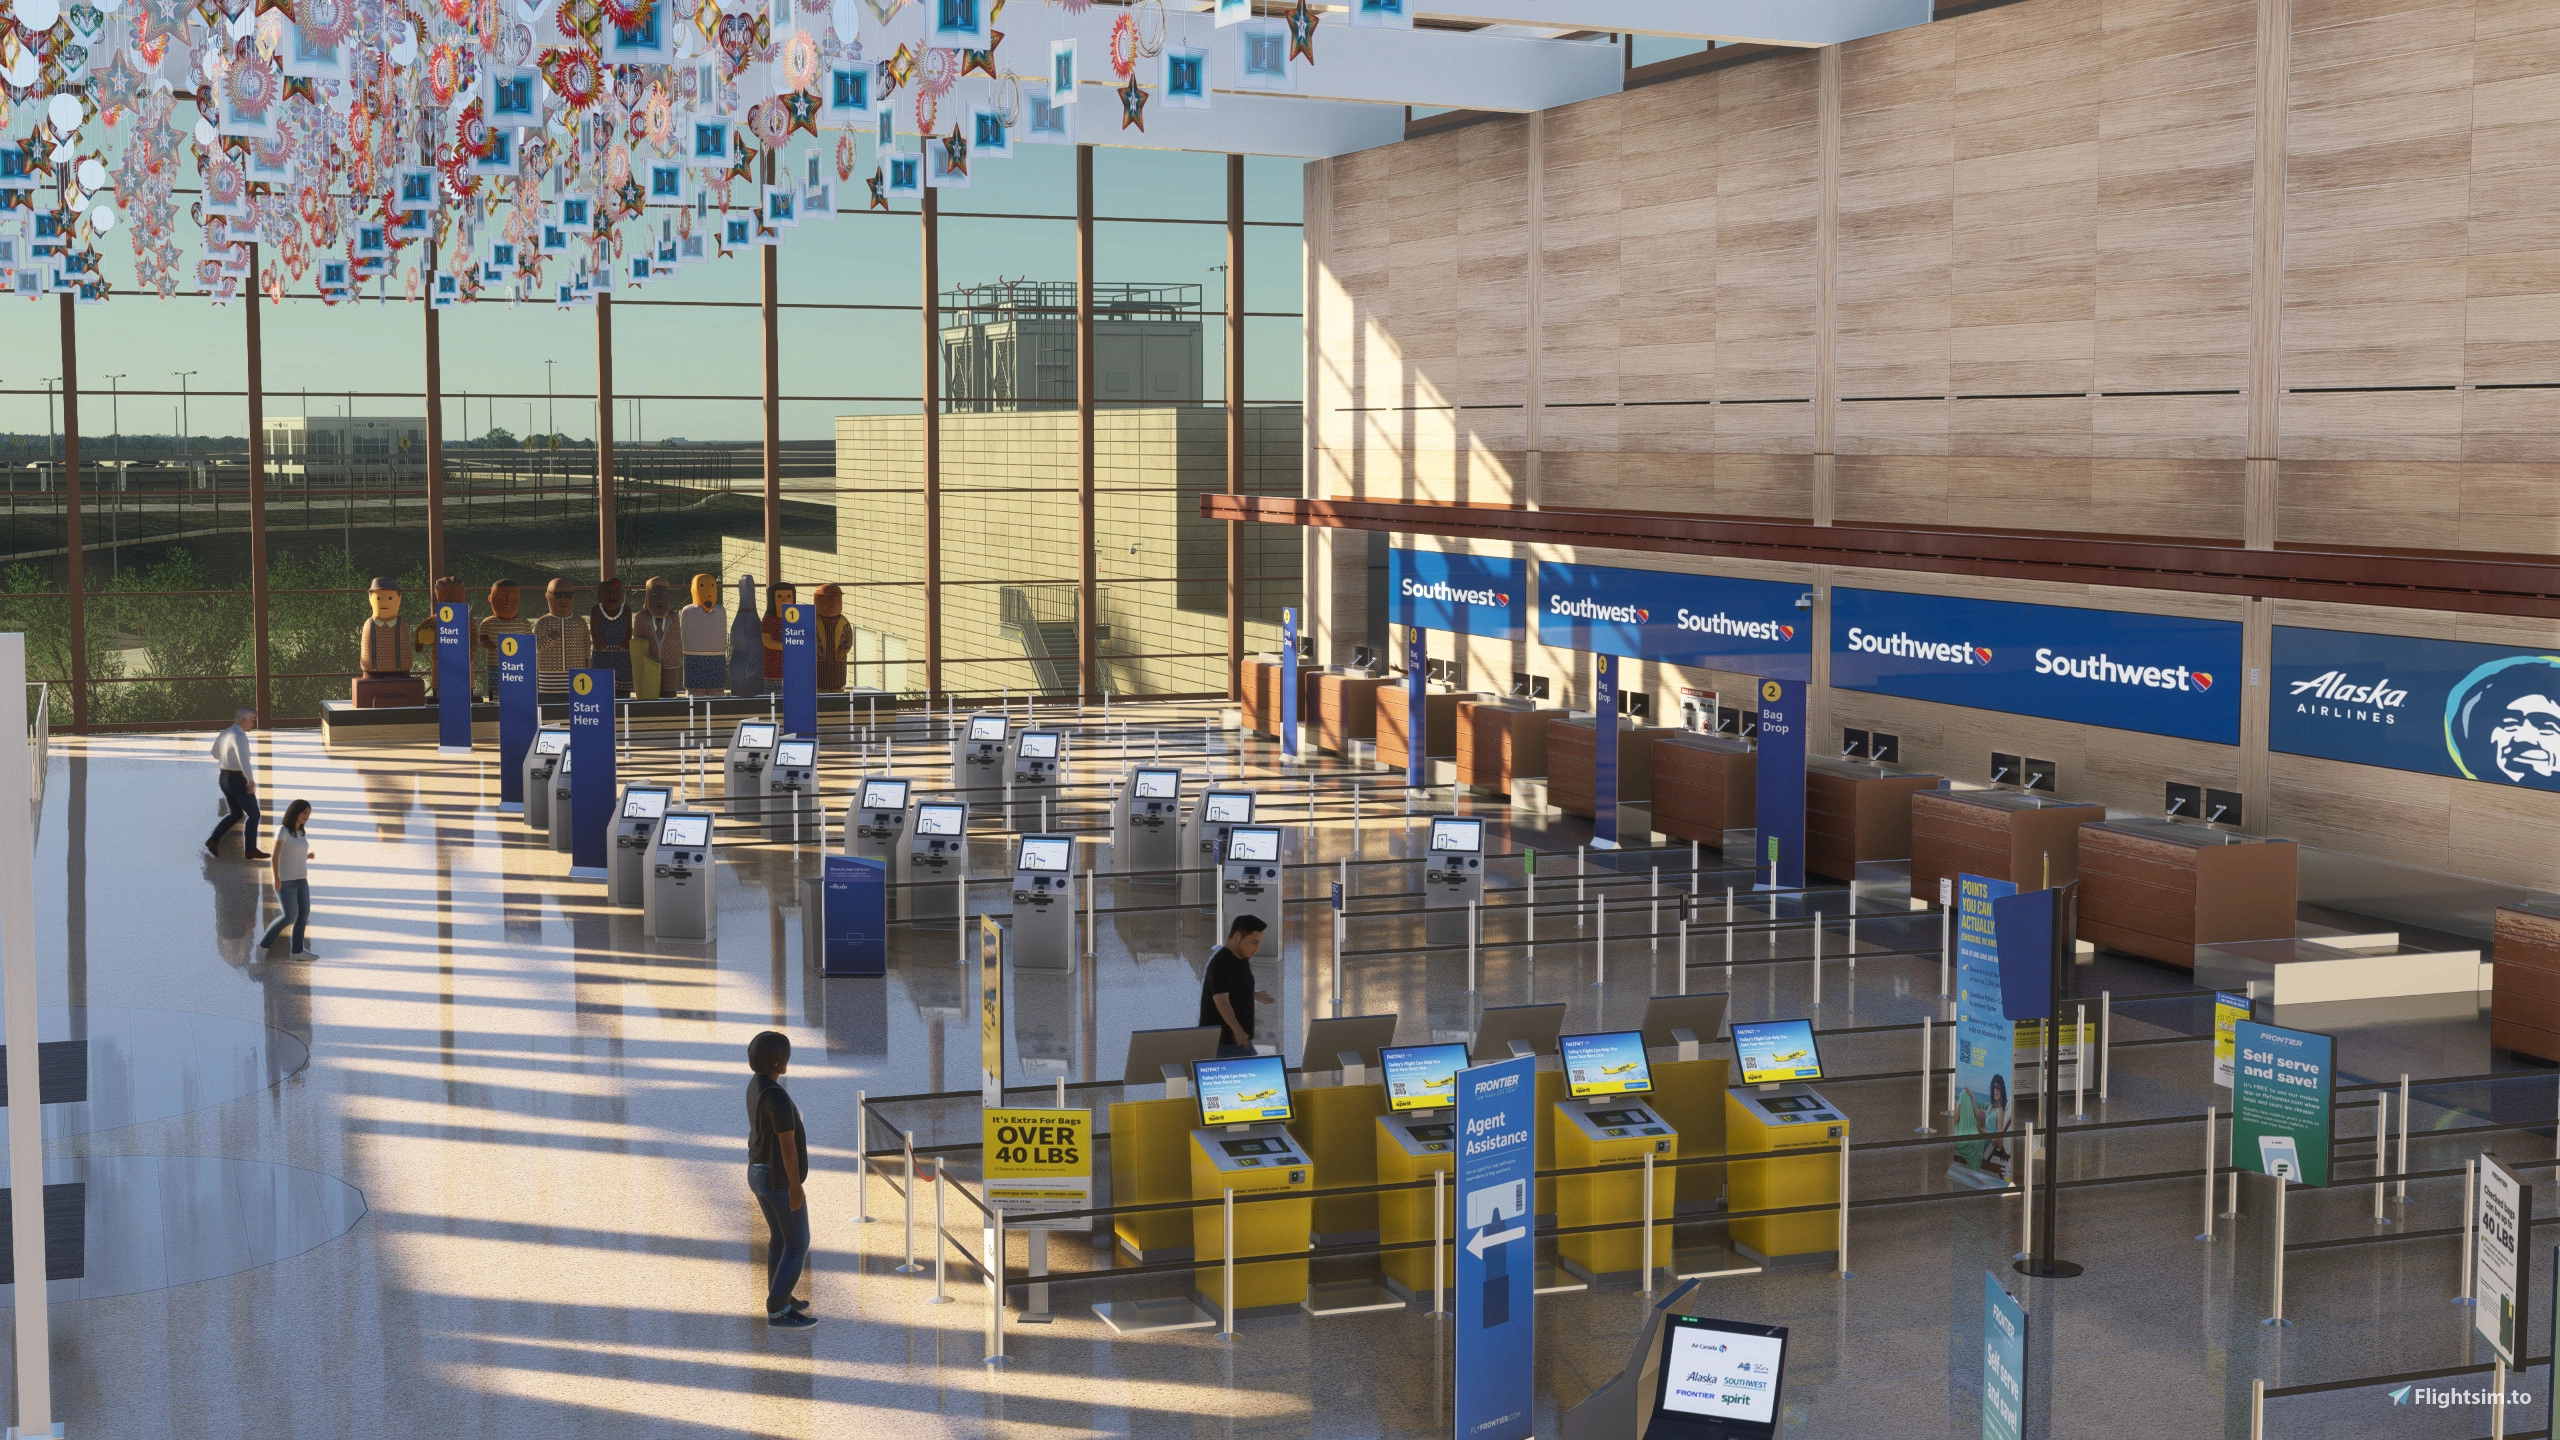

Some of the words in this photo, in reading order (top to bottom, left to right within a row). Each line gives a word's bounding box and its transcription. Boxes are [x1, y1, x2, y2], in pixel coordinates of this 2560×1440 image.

[1402, 578, 1495, 606] Southwest
[444, 609, 449, 619] 1
[789, 610, 795, 620] 1
[1550, 595, 1637, 624] Southwest
[439, 626, 459, 636] Start
[785, 627, 805, 636] Start
[1677, 608, 1779, 641] Southwest
[439, 636, 459, 645] Here
[506, 641, 512, 652] 1
[785, 637, 805, 645] Here
[1848, 627, 1973, 665] Southwest
[501, 661, 525, 672] Start
[2035, 647, 2190, 691] Southwest
[501, 672, 524, 682] Here
[579, 678, 586, 691] 1
[1598, 680, 1608, 692] Bag
[1768, 686, 1776, 697] 2
[2290, 670, 2408, 709] Alaska
[1598, 692, 1611, 704] Drop
[573, 701, 600, 713] Start
[2296, 703, 2395, 725] AIRLINES
[573, 714, 600, 726] Here
[1763, 709, 1783, 722] Bag
[1763, 722, 1789, 735] Drop
[1962, 879, 1988, 899] POINTS
[1962, 896, 1977, 914] YOU
[1977, 900, 1992, 917] CAN
[1961, 914, 1995, 936] ACTUALLY
[2260, 1032, 2303, 1047] FRONTIER
[2243, 1048, 2274, 1065] Self
[2277, 1057, 2319, 1074] serve
[2243, 1065, 2273, 1080] and
[2277, 1072, 2318, 1089] save!
[1474, 1074, 1519, 1095] FRONTIER
[2253, 1083, 2269, 1092] FREE
[2304, 1101, 2320, 1110] where
[992, 1116, 1008, 1124] It's
[1011, 1116, 1037, 1124] Extra
[1058, 1117, 1082, 1126] Bags
[1466, 1112, 1505, 1136] Agent
[997, 1126, 1075, 1145] OVER
[1466, 1130, 1528, 1156] Assistance
[995, 1147, 1028, 1163] 40
[1034, 1147, 1079, 1164] LBS
[2484, 1184, 2503, 1209] Checked
[2503, 1200, 2515, 1220] bags
[2485, 1200, 2494, 1212] can
[2494, 1204, 2500, 1219] be
[2501, 1213, 2507, 1226] up
[2507, 1218, 2513, 1230] to
[2482, 1212, 2495, 1235] 40
[2496, 1222, 2514, 1254] LBS
[1992, 1303, 2015, 1341] FRONTIER
[1699, 1343, 1717, 1351] Canada
[1686, 1371, 1717, 1384] Alaska
[1987, 1343, 2000, 1376] Self
[2000, 1364, 2019, 1401] serve
[1724, 1376, 1768, 1389] SOUTHWEST
[1676, 1389, 1715, 1399] FRONTIER
[1721, 1394, 1751, 1405] spirit
[1987, 1381, 2000, 1412] and
[2000, 1398, 2017, 1435] save!
[1470, 1411, 1521, 1434] FLYFRONTIER.COM
